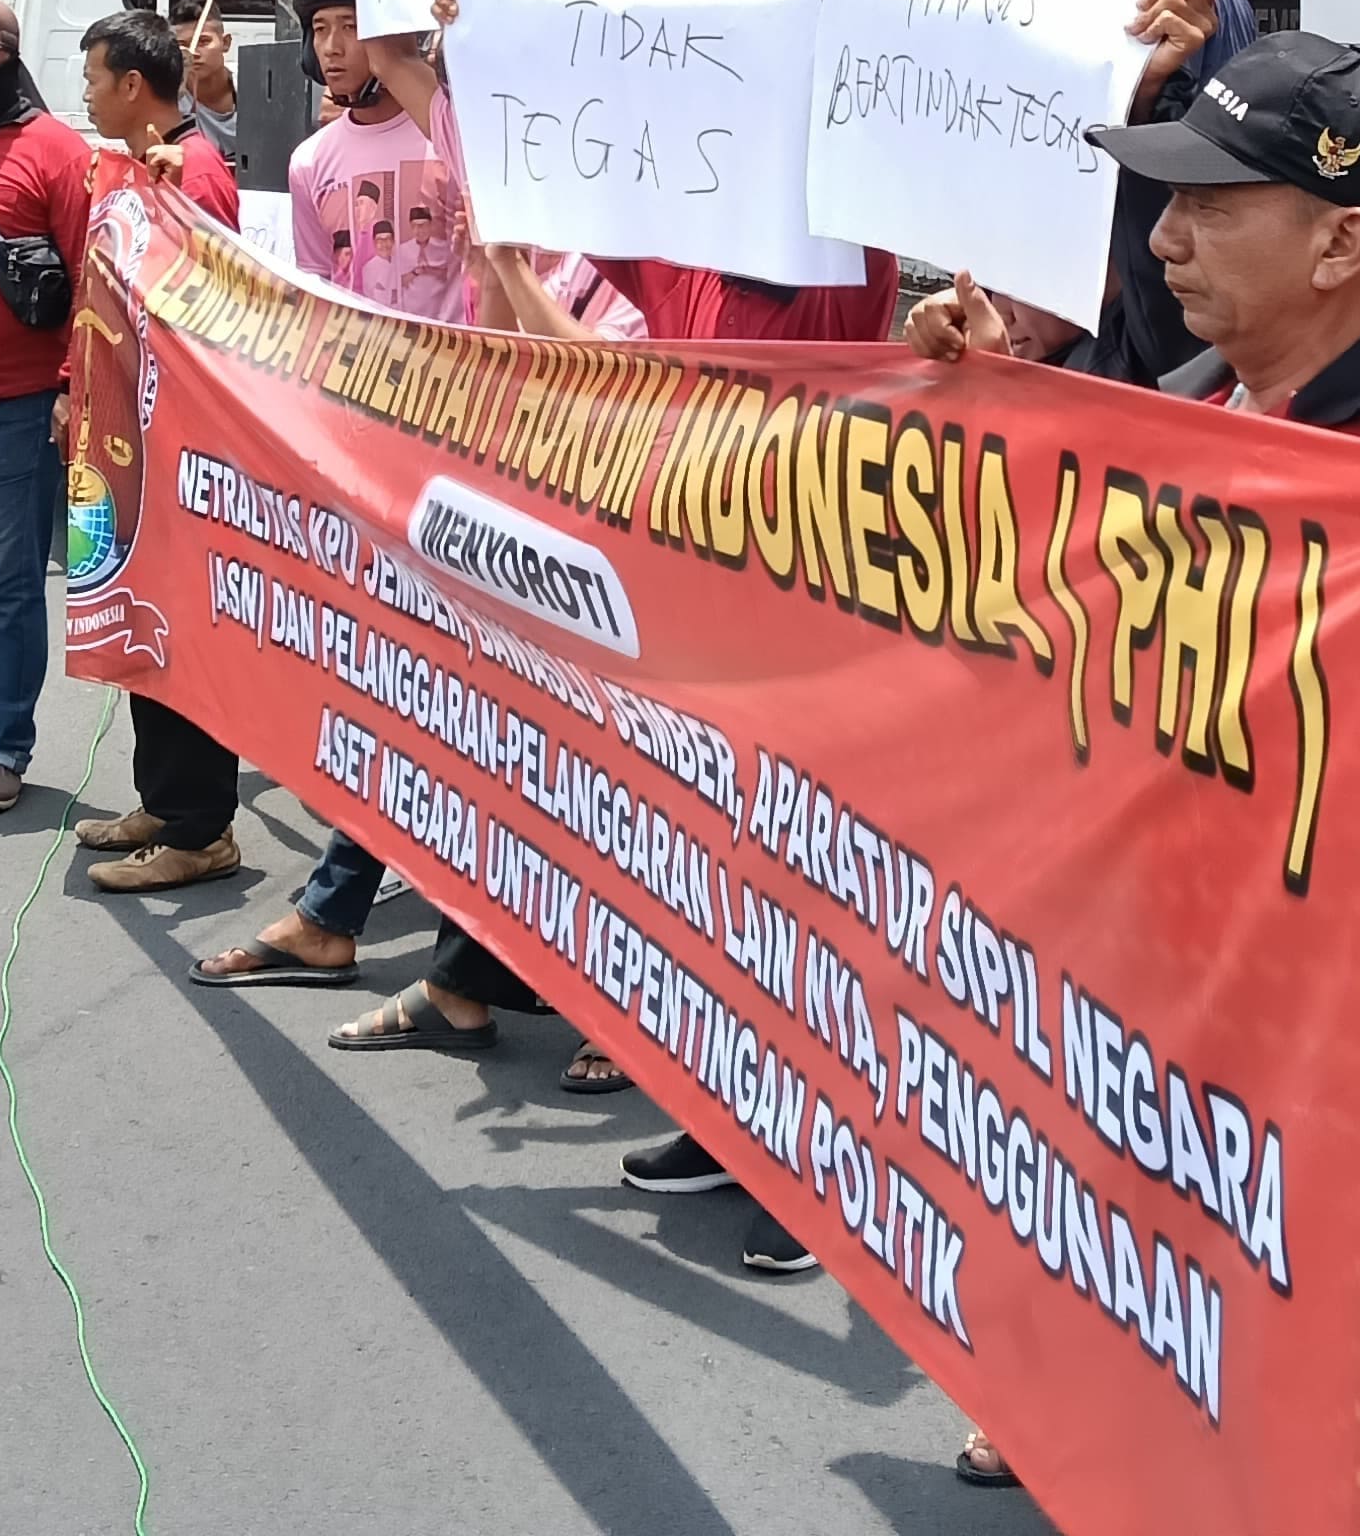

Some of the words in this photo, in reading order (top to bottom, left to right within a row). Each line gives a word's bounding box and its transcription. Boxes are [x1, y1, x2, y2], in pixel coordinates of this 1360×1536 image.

[492, 92, 733, 195] TEGAS
[826, 43, 1003, 141] BERTINDAK
[143, 230, 315, 374] LEMBAGA
[302, 299, 513, 457] PEMERHATI
[503, 340, 683, 522] HUKUM
[648, 364, 1054, 674] INDONESIA
[420, 499, 621, 638] MENYOROTI
[74, 604, 125, 635] INDONESIA
[178, 449, 309, 560] NETRALITAS
[308, 500, 360, 587] KPU
[596, 677, 743, 842] JEMBER,
[750, 746, 934, 978] APARATUR
[936, 890, 1052, 1080] SIPIL
[1062, 976, 1290, 1292] NEGARA
[271, 579, 316, 663] DAN
[321, 605, 715, 939] PELANGGARAN-PELANGGARAN
[717, 864, 798, 1012] LAIN
[804, 931, 888, 1119] NYA,
[895, 1009, 1222, 1424] PENGGUNAAN
[315, 706, 377, 800] ASET
[378, 745, 478, 881] NEGARA
[485, 818, 581, 964] UNTUK
[582, 896, 806, 1175] KEPENTINGAN
[811, 1096, 972, 1352] POLITIK
